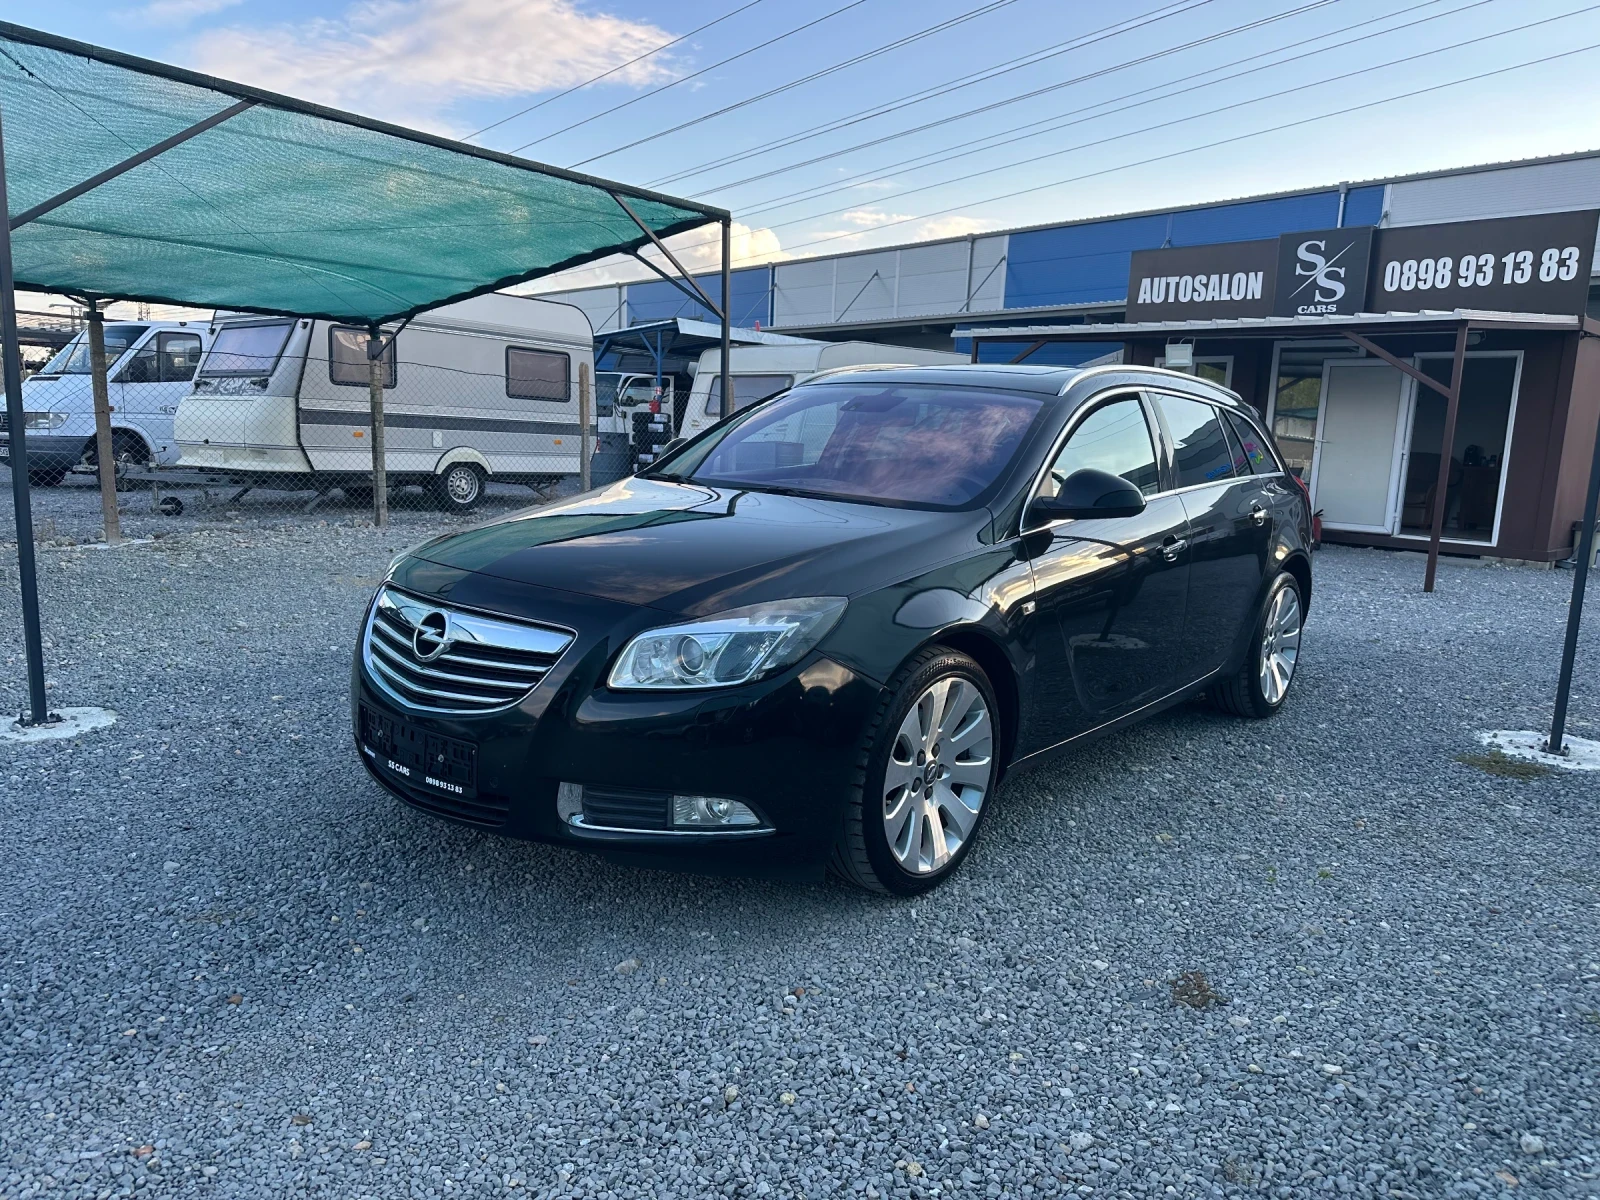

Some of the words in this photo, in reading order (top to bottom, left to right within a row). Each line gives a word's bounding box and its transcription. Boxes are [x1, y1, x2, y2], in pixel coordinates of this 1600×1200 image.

[1384, 256, 1453, 292] 0898
[1457, 253, 1495, 288] 93
[1501, 250, 1534, 285] 13
[1539, 246, 1580, 283] 83
[1137, 271, 1264, 304] AUTOSALON
[1297, 304, 1337, 315] CARS
[395, 763, 410, 776] CARS
[440, 781, 447, 789] 93
[447, 783, 455, 791] 13
[455, 785, 463, 794] 83
